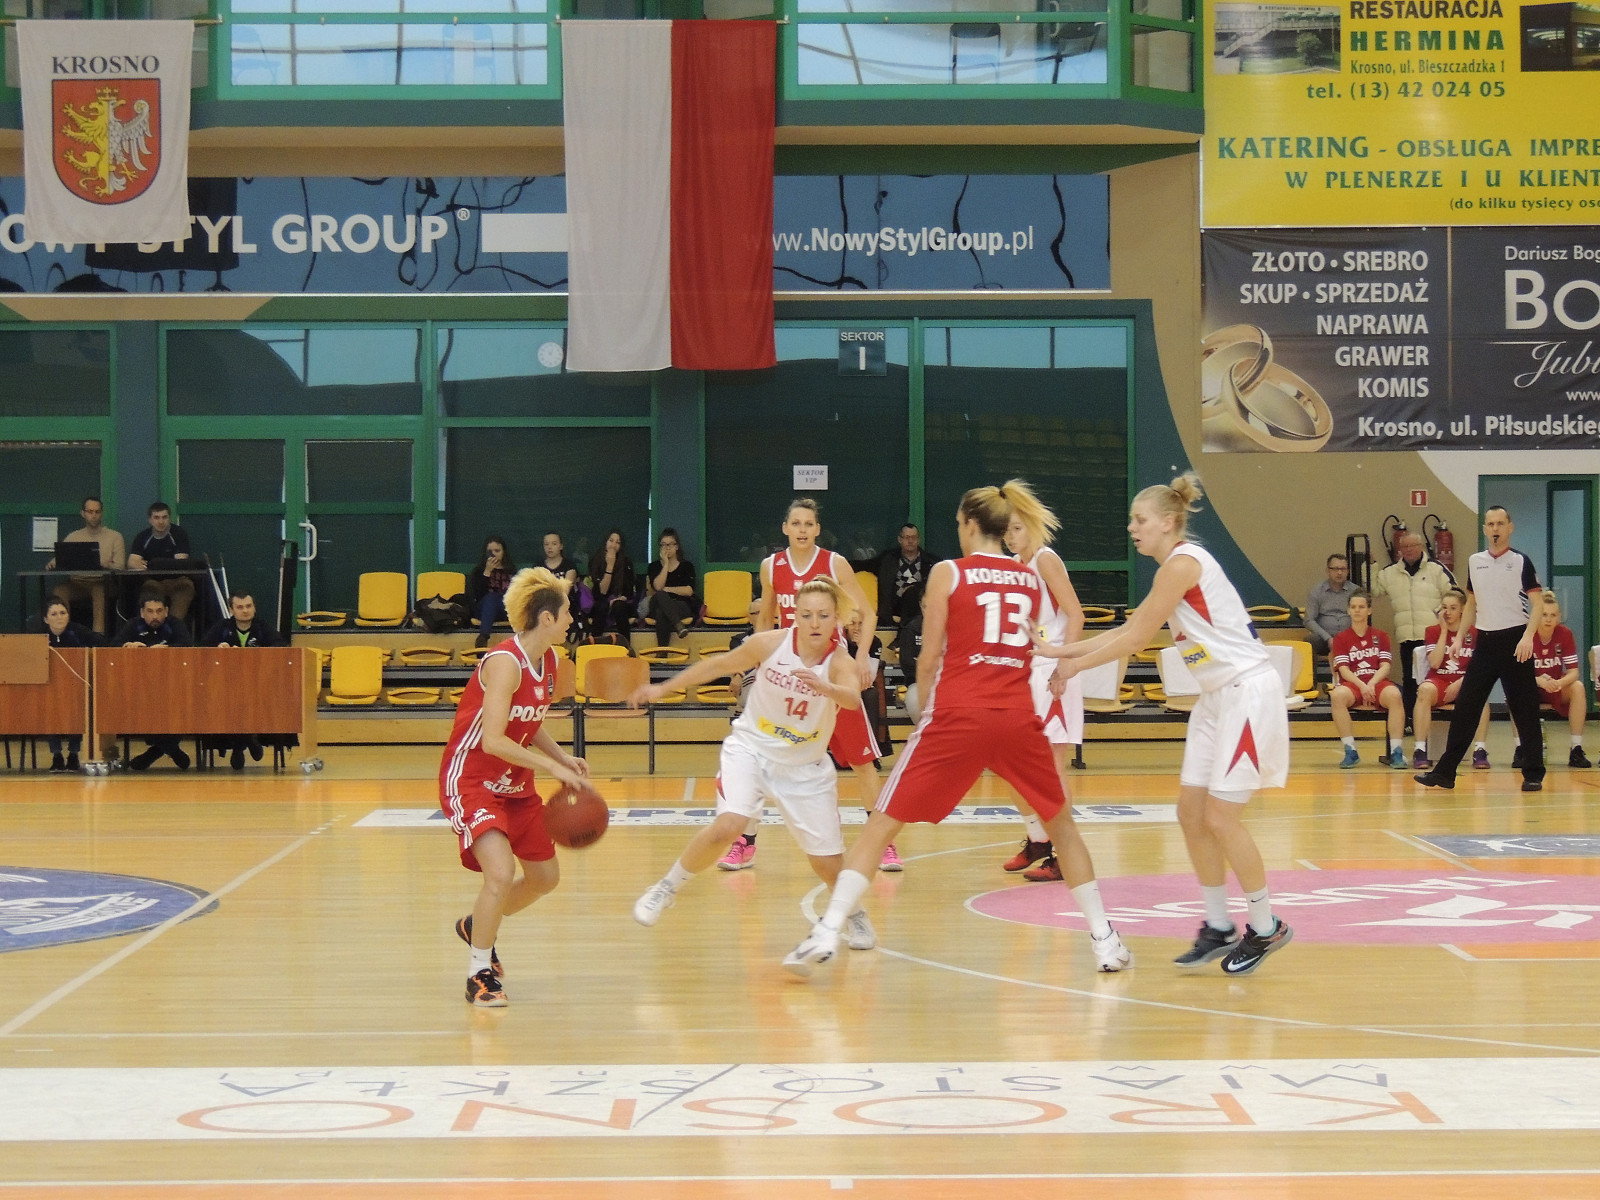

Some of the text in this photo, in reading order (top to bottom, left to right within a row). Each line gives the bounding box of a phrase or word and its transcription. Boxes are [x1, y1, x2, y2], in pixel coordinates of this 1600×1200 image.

[1350, 0, 1504, 19] RESTAURACJA
[1350, 30, 1505, 52] HERMINA
[52, 55, 161, 75] KROSNO
[1350, 60, 1396, 76] Krosno,
[1419, 58, 1496, 74] Bieszczadzka
[1306, 81, 1506, 100] tel. (13) 42 024 05
[1218, 136, 1369, 159] KATERING
[1397, 138, 1512, 158] OBSŁUGA
[1285, 171, 1308, 188] W
[1325, 170, 1443, 188] PLENERZE
[1485, 169, 1501, 187] U
[1450, 198, 1474, 211] (do
[1479, 198, 1516, 209] kilku
[1251, 250, 1429, 273] ZŁOTO SREBRO
[1505, 245, 1568, 261] Dariusz
[1240, 277, 1429, 304] SKUP SPRZEDAŻ
[1316, 314, 1429, 335] NAPRAWA
[840, 331, 885, 342] SEKTOR
[1335, 345, 1429, 367] GRAWER
[1358, 377, 1429, 398] KOMIS
[1358, 414, 1600, 440] Krosno, ul. Piłsudskie
[975, 591, 1033, 648] 13
[765, 667, 792, 690] CZECH
[784, 697, 809, 721] 14
[175, 1091, 1447, 1134] KROSNO
